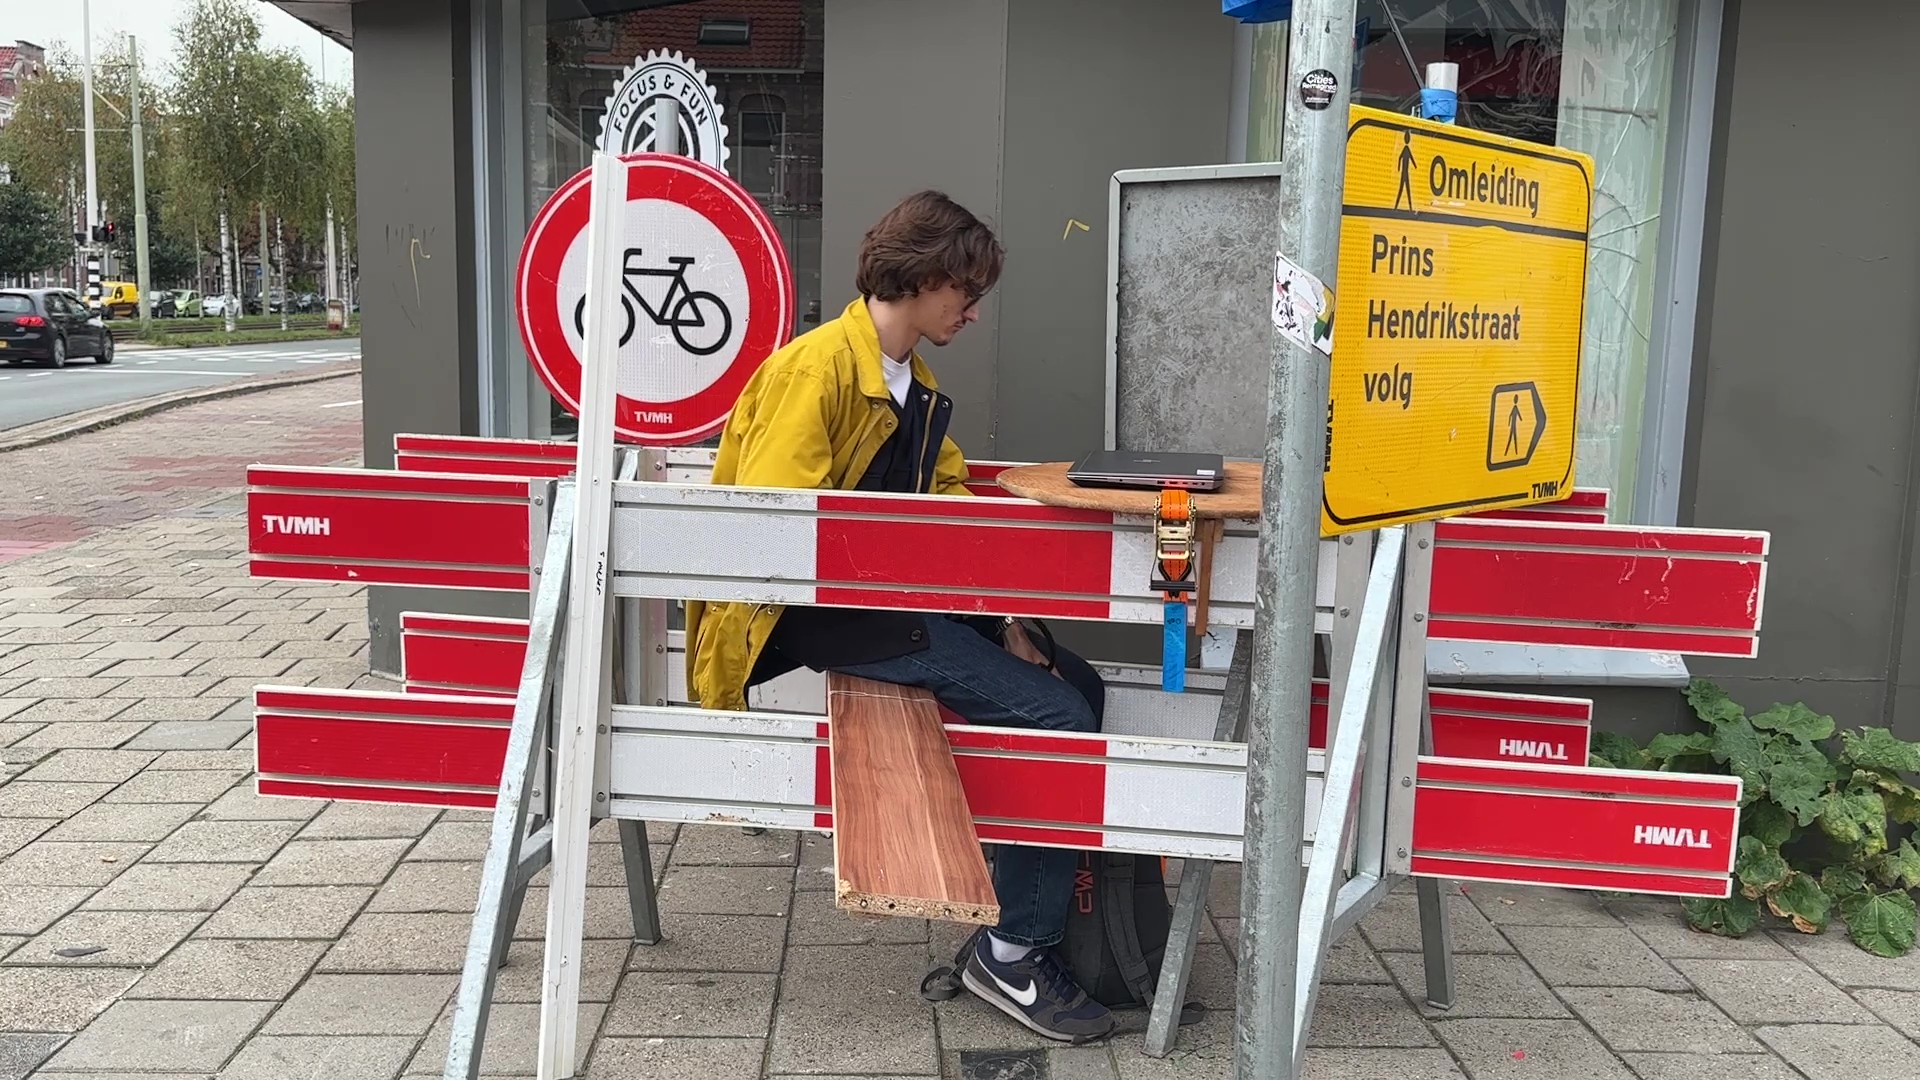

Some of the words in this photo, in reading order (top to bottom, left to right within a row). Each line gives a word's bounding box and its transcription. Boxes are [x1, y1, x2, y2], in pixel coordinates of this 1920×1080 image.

[1306, 74, 1334, 85] Cities
[613, 75, 656, 133] FOCUS
[664, 74, 675, 90] &
[680, 83, 708, 127] FUN
[1429, 155, 1540, 219] Omleiding
[1371, 234, 1434, 277] Prins
[1367, 299, 1521, 341] Hendrikstraat
[1363, 362, 1413, 410] volg
[633, 410, 673, 424] TVMH
[1532, 480, 1558, 499] TVMH
[262, 514, 330, 536] TVMH
[1499, 738, 1568, 760] TVMH
[1633, 825, 1712, 848] TVMH
